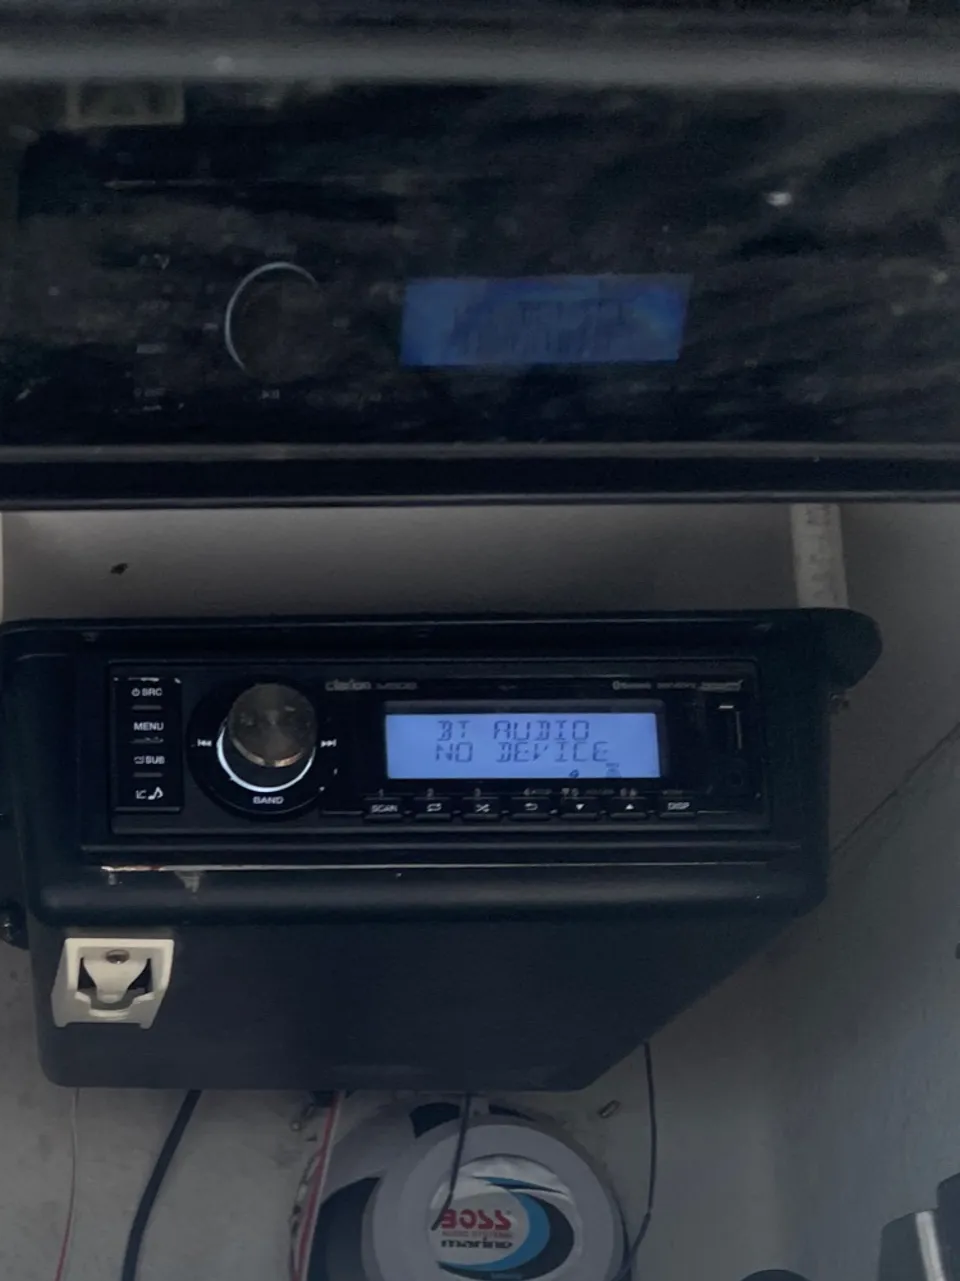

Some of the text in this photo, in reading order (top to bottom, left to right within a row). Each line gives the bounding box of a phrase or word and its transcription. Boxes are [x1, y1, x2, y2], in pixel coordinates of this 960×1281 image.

[141, 688, 163, 697] SRC
[133, 722, 165, 732] MENU
[437, 720, 590, 741] BT AUDIO
[436, 741, 609, 763] NO DEVICE
[145, 756, 165, 765] SUB
[253, 796, 284, 805] BAND
[371, 804, 399, 813] SCAN
[441, 1208, 512, 1231] BOSS
